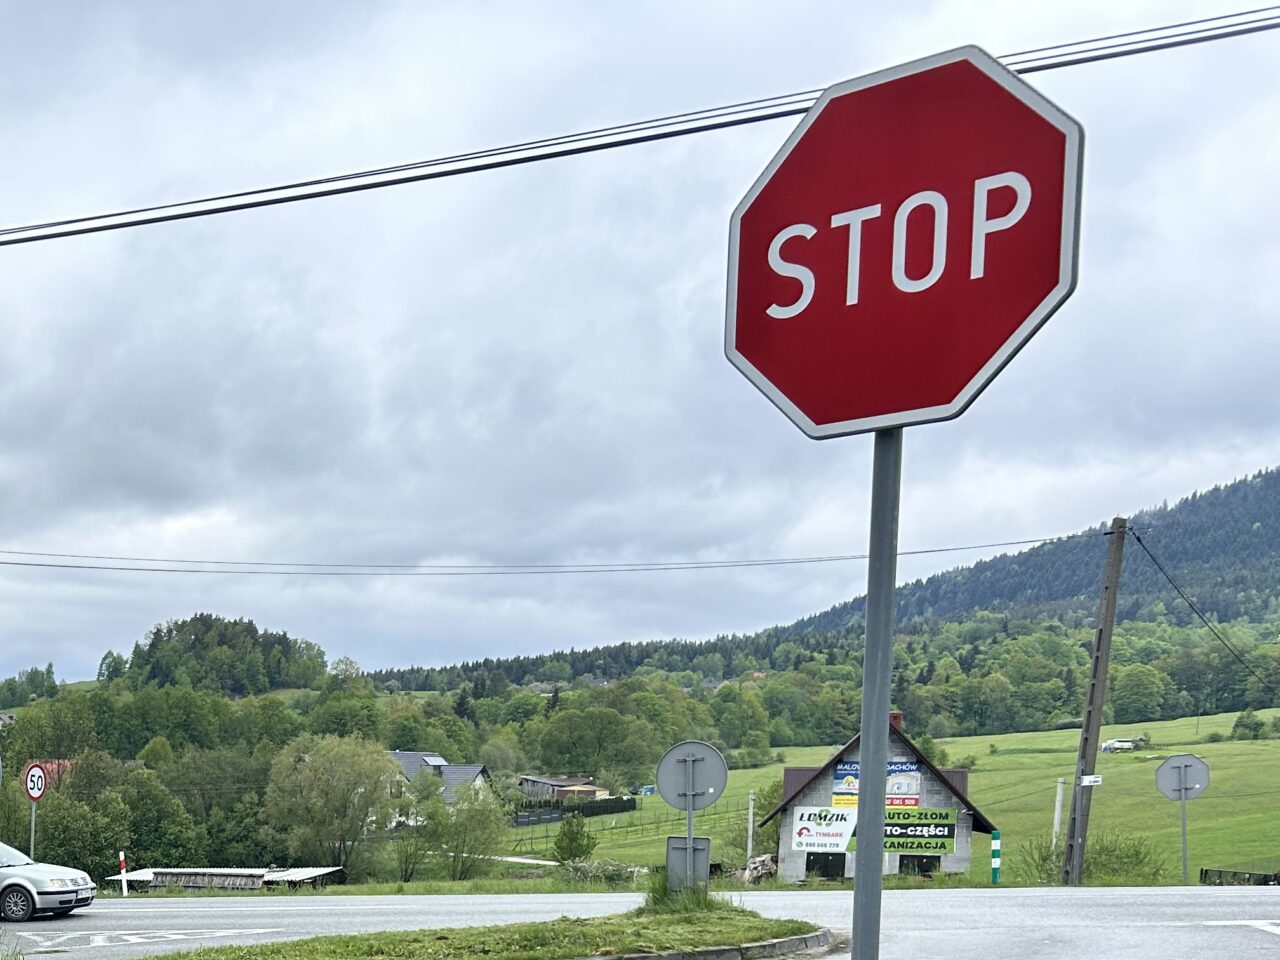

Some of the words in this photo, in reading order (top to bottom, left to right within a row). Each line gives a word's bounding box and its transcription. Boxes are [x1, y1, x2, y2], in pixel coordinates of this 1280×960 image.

[765, 171, 1032, 320] STOP
[29, 774, 43, 791] 50
[885, 811, 949, 820] UTO-ZŁOM
[884, 824, 949, 837] TO-CZĘŚCI
[883, 841, 947, 850] KANIZACJA
